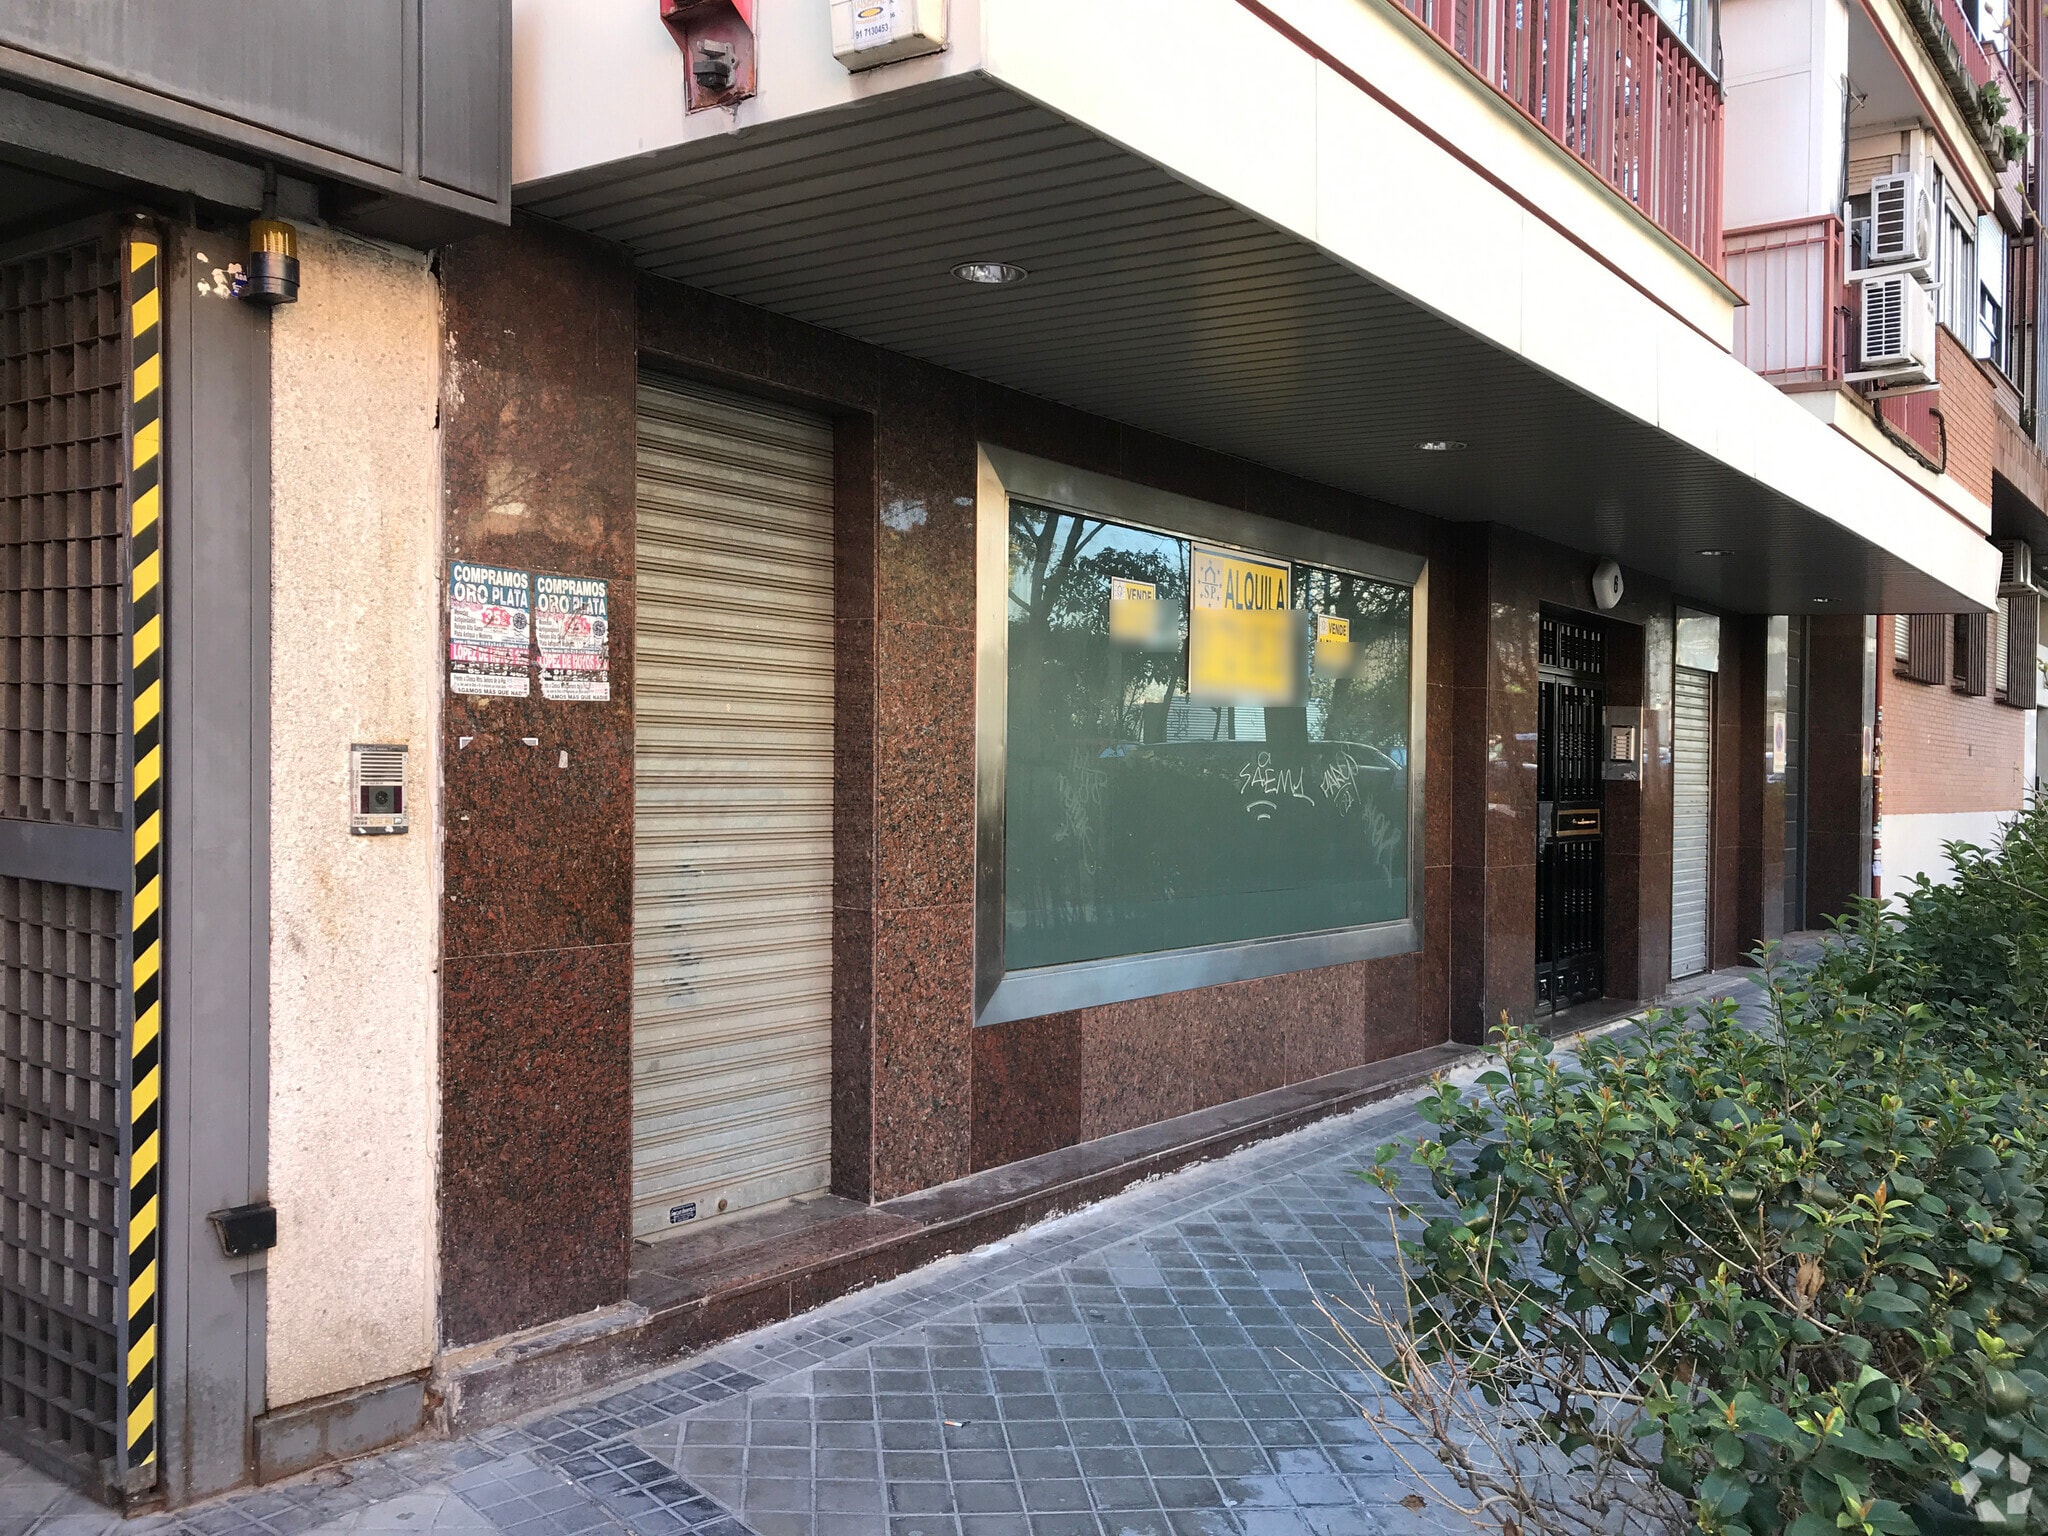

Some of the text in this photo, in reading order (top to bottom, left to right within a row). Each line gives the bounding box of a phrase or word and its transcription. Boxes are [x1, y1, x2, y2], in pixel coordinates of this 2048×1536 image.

[454, 565, 528, 589] COMPRAMOS
[538, 577, 606, 597] COMPRAMOS
[1613, 575, 1619, 594] 6
[454, 582, 489, 604] ORO
[492, 586, 528, 608] PLATA
[1126, 587, 1152, 600] VENDE
[1204, 584, 1216, 599] SP
[1225, 568, 1284, 610] ALQUILA
[538, 593, 569, 613] ORO
[573, 596, 606, 616] PLATA
[1328, 622, 1347, 637] VENDE
